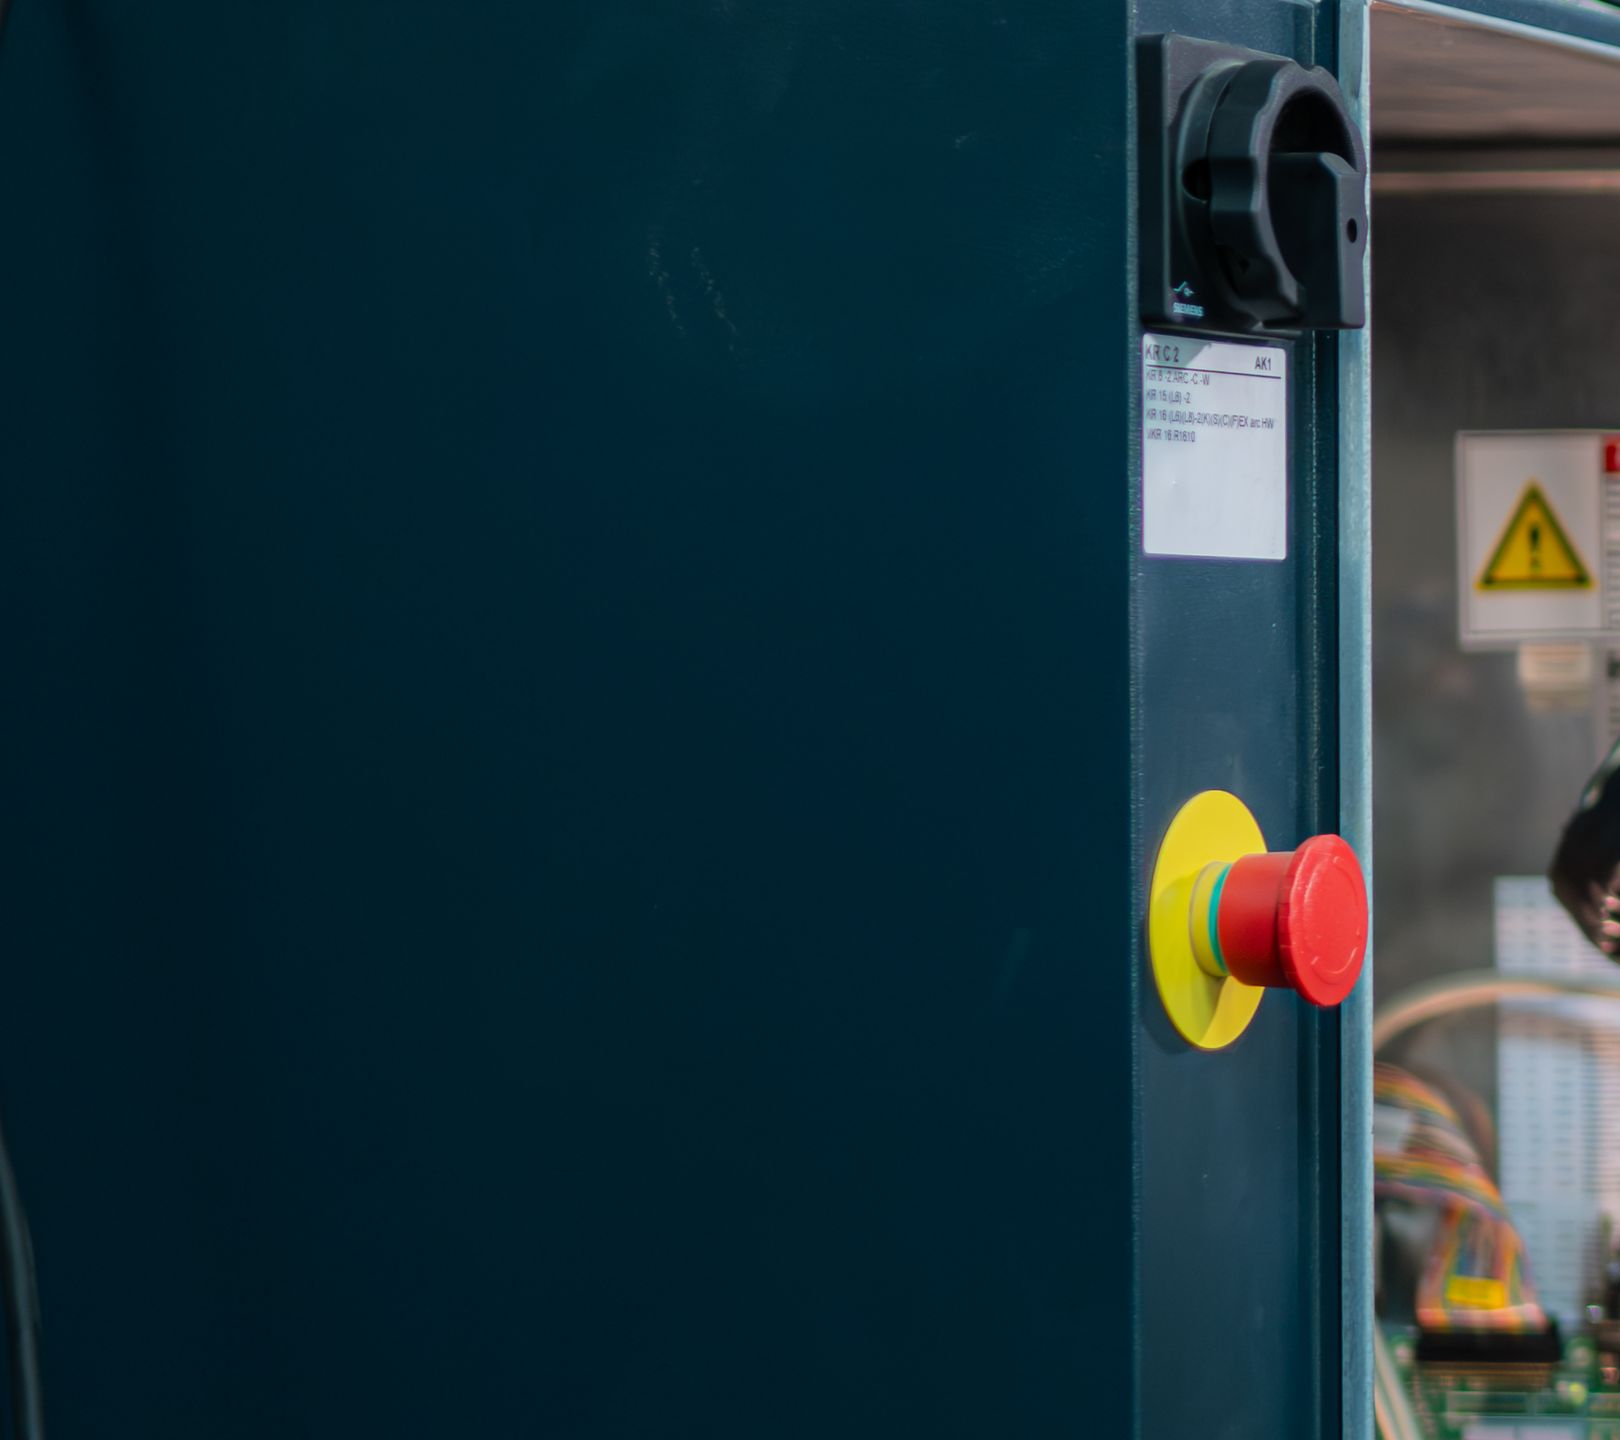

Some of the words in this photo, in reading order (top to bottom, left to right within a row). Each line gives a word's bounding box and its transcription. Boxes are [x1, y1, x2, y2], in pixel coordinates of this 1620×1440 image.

[1173, 302, 1204, 317] SIEMENS
[1146, 344, 1160, 362] KR
[1163, 346, 1171, 362] C
[1173, 347, 1180, 363] 2
[1254, 356, 1272, 371] AK1
[1261, 418, 1275, 430] HW
